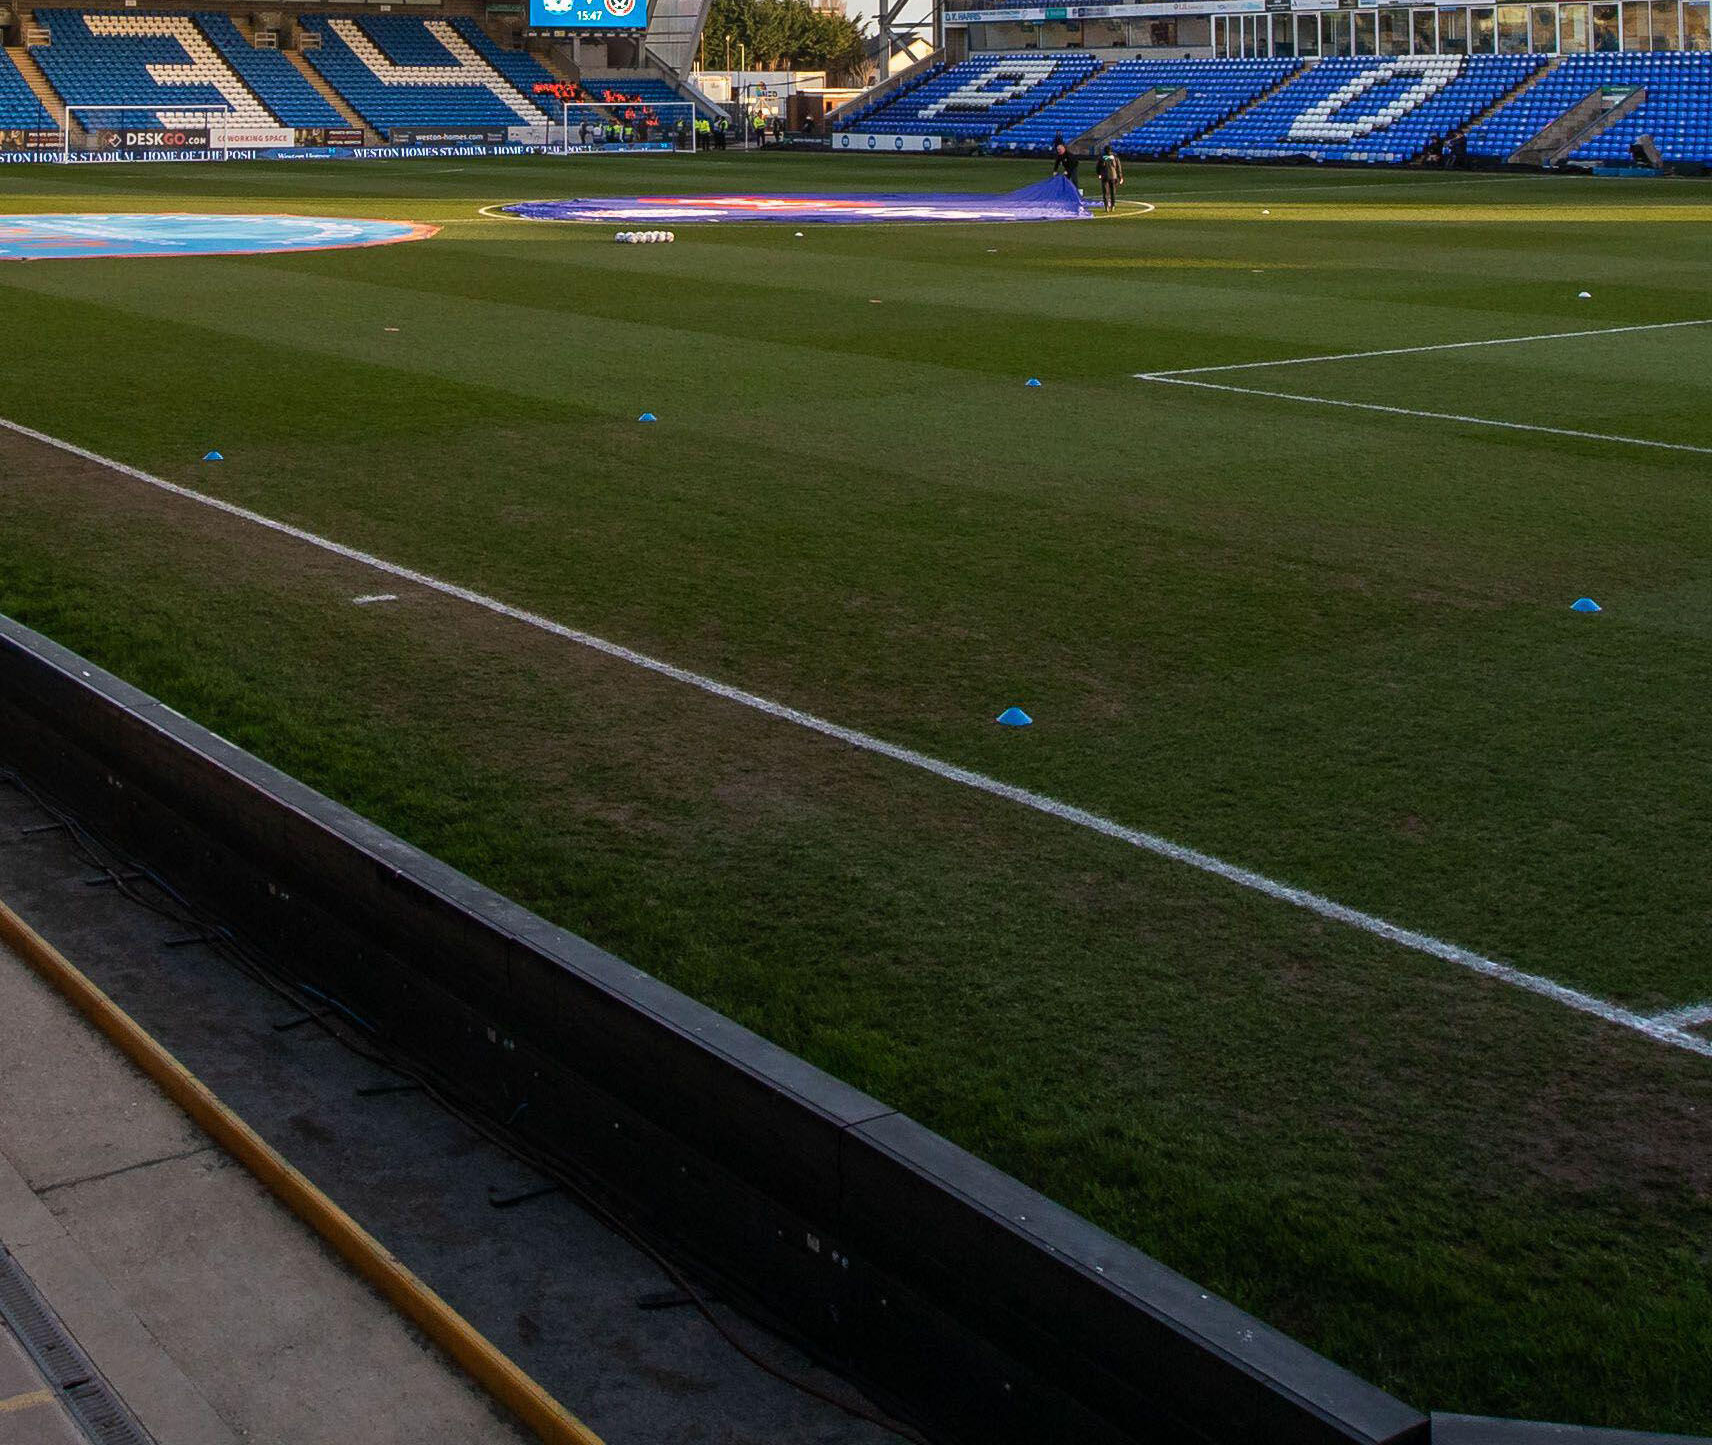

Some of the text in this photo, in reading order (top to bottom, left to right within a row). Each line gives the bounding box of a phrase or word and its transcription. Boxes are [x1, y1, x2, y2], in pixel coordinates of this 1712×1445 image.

[576, 10, 603, 21] 15:47
[126, 133, 207, 146] DESKGO.COM
[415, 132, 484, 142] weston-homes.com
[33, 152, 74, 163] HOMES
[75, 151, 134, 162] STADIUM
[143, 150, 177, 161] HOME
[180, 150, 196, 160] OF
[197, 149, 225, 160] THE
[225, 149, 257, 160] POSH
[353, 147, 397, 158] WESTON
[400, 147, 438, 157] HOMES
[439, 146, 486, 157] STADIUM
[493, 145, 525, 156] HOME
